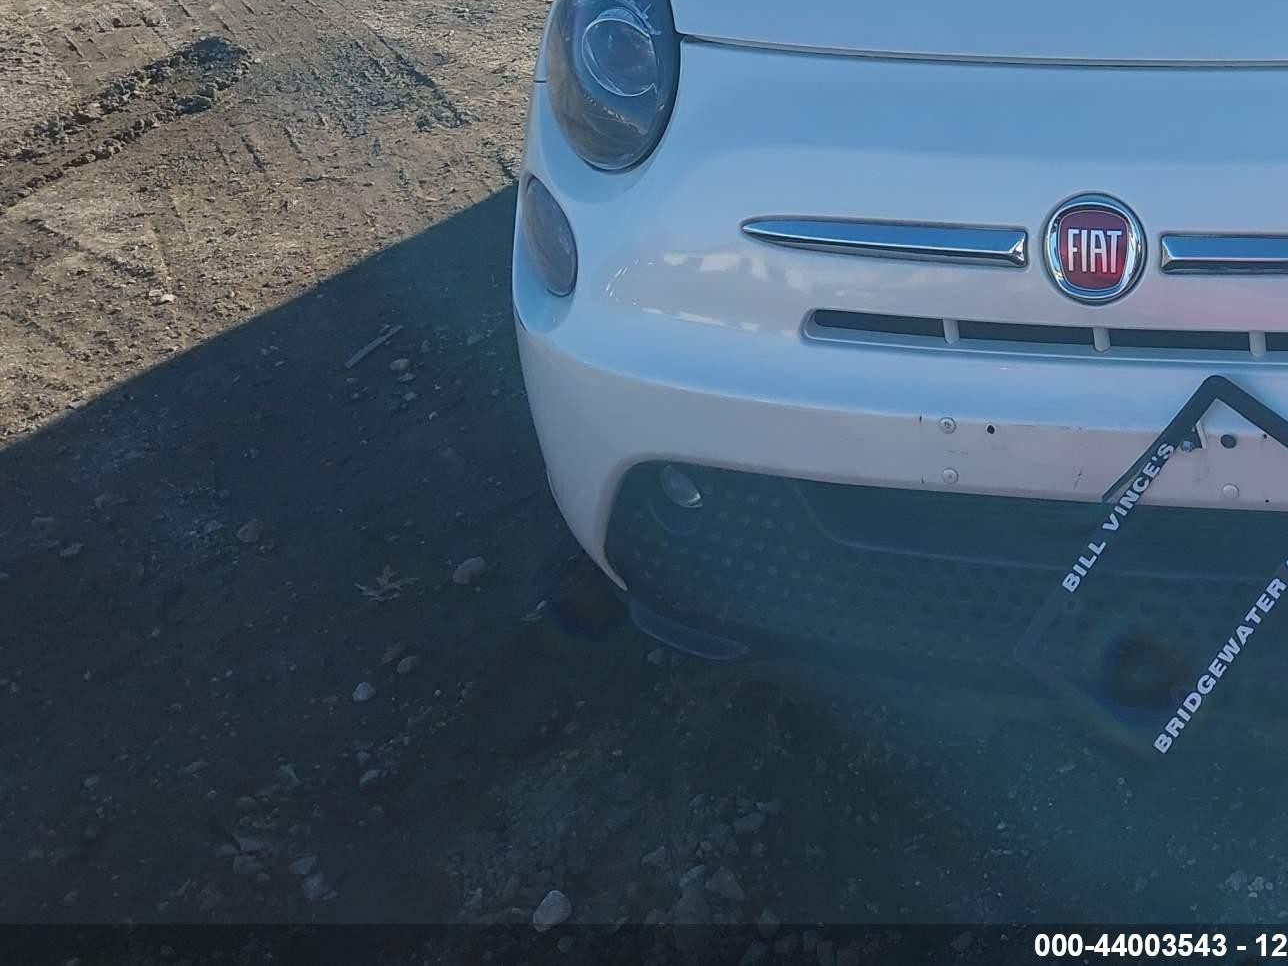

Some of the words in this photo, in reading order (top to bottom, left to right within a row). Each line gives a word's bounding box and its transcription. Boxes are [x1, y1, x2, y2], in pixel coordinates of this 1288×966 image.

[1067, 228, 1123, 274] FIAT
[1062, 541, 1107, 592] BILL
[1102, 443, 1175, 531] VINCE'S
[1153, 577, 1288, 754] BRIDGEWATER
